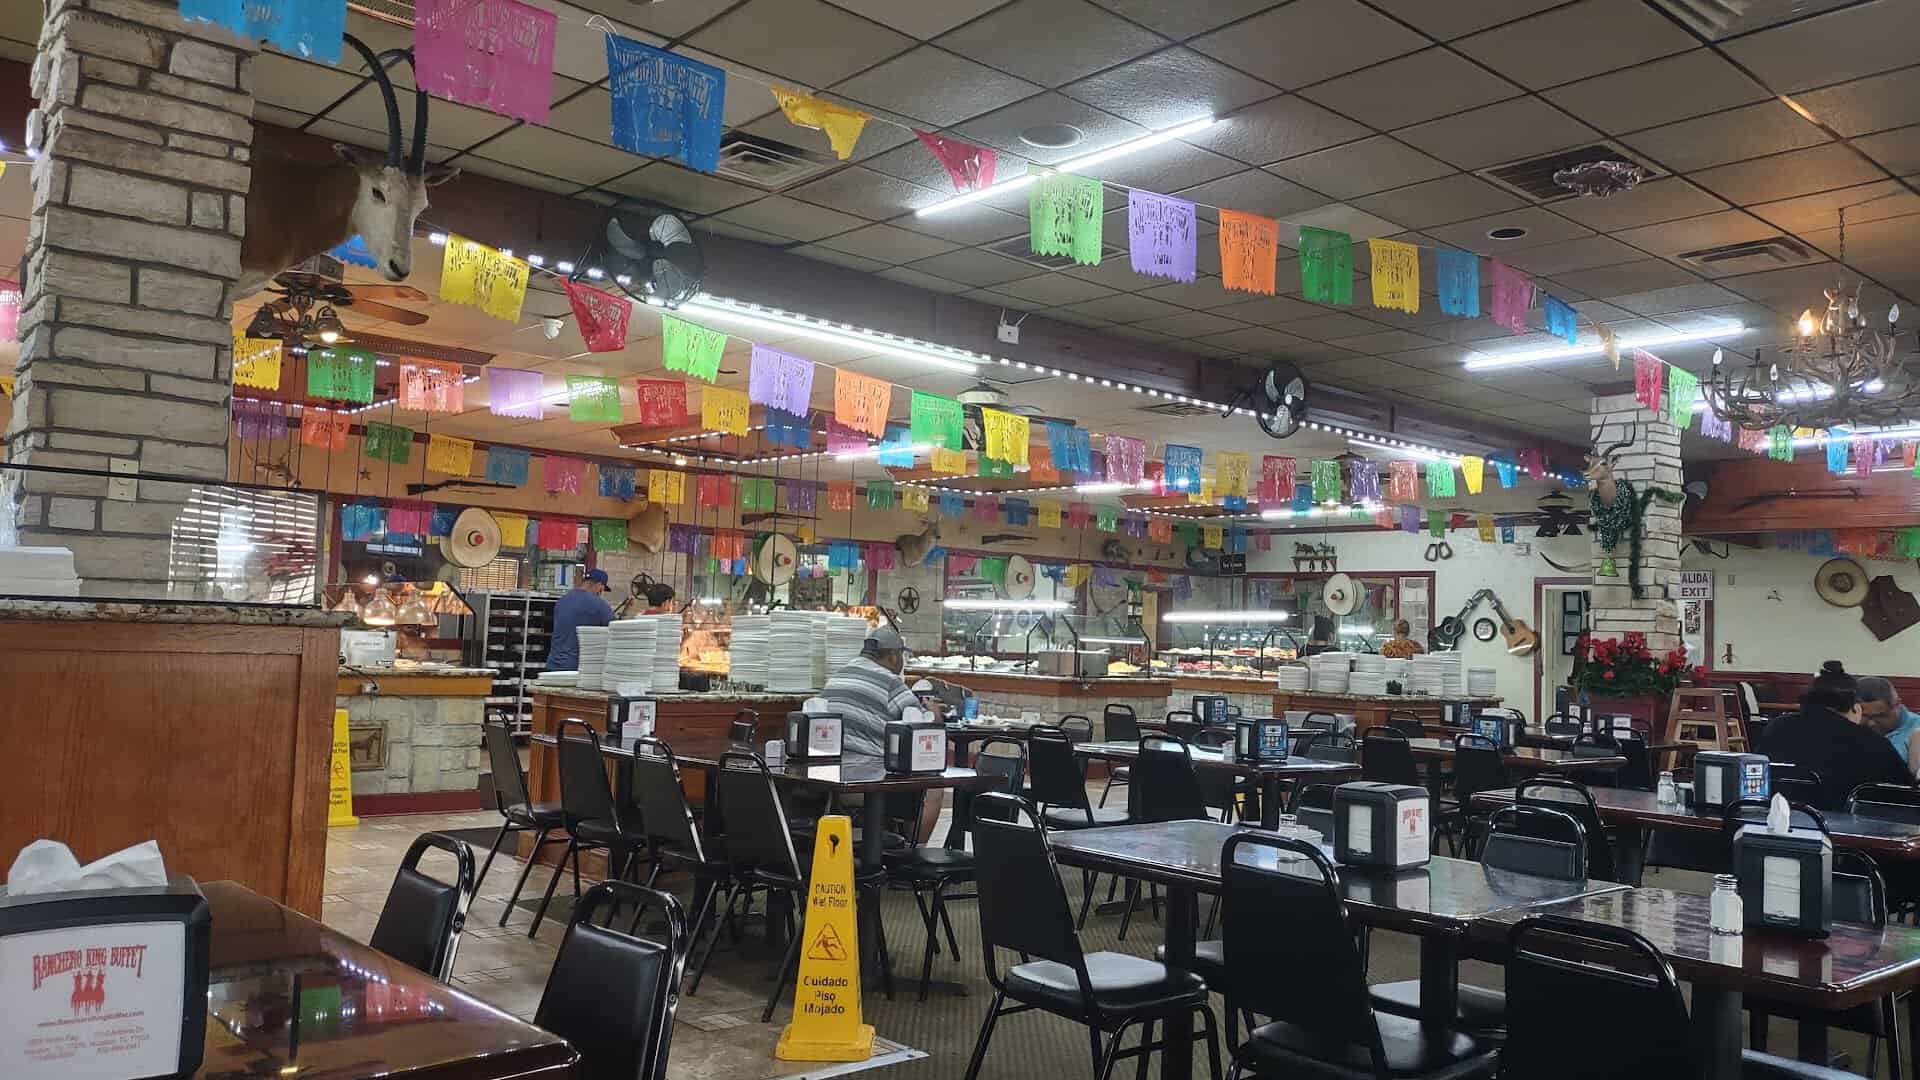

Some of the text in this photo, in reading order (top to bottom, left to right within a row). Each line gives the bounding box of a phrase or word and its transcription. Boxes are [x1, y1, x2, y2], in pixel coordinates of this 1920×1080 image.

[1681, 572, 1709, 584] ALIDA
[1681, 587, 1709, 597] EXIT
[815, 883, 847, 895] CAUTION
[828, 896, 848, 907] Floor
[110, 944, 147, 978] BUFFET
[803, 975, 848, 987] Cuidado
[815, 990, 836, 1001] Piso
[804, 1002, 846, 1016] Mojado
